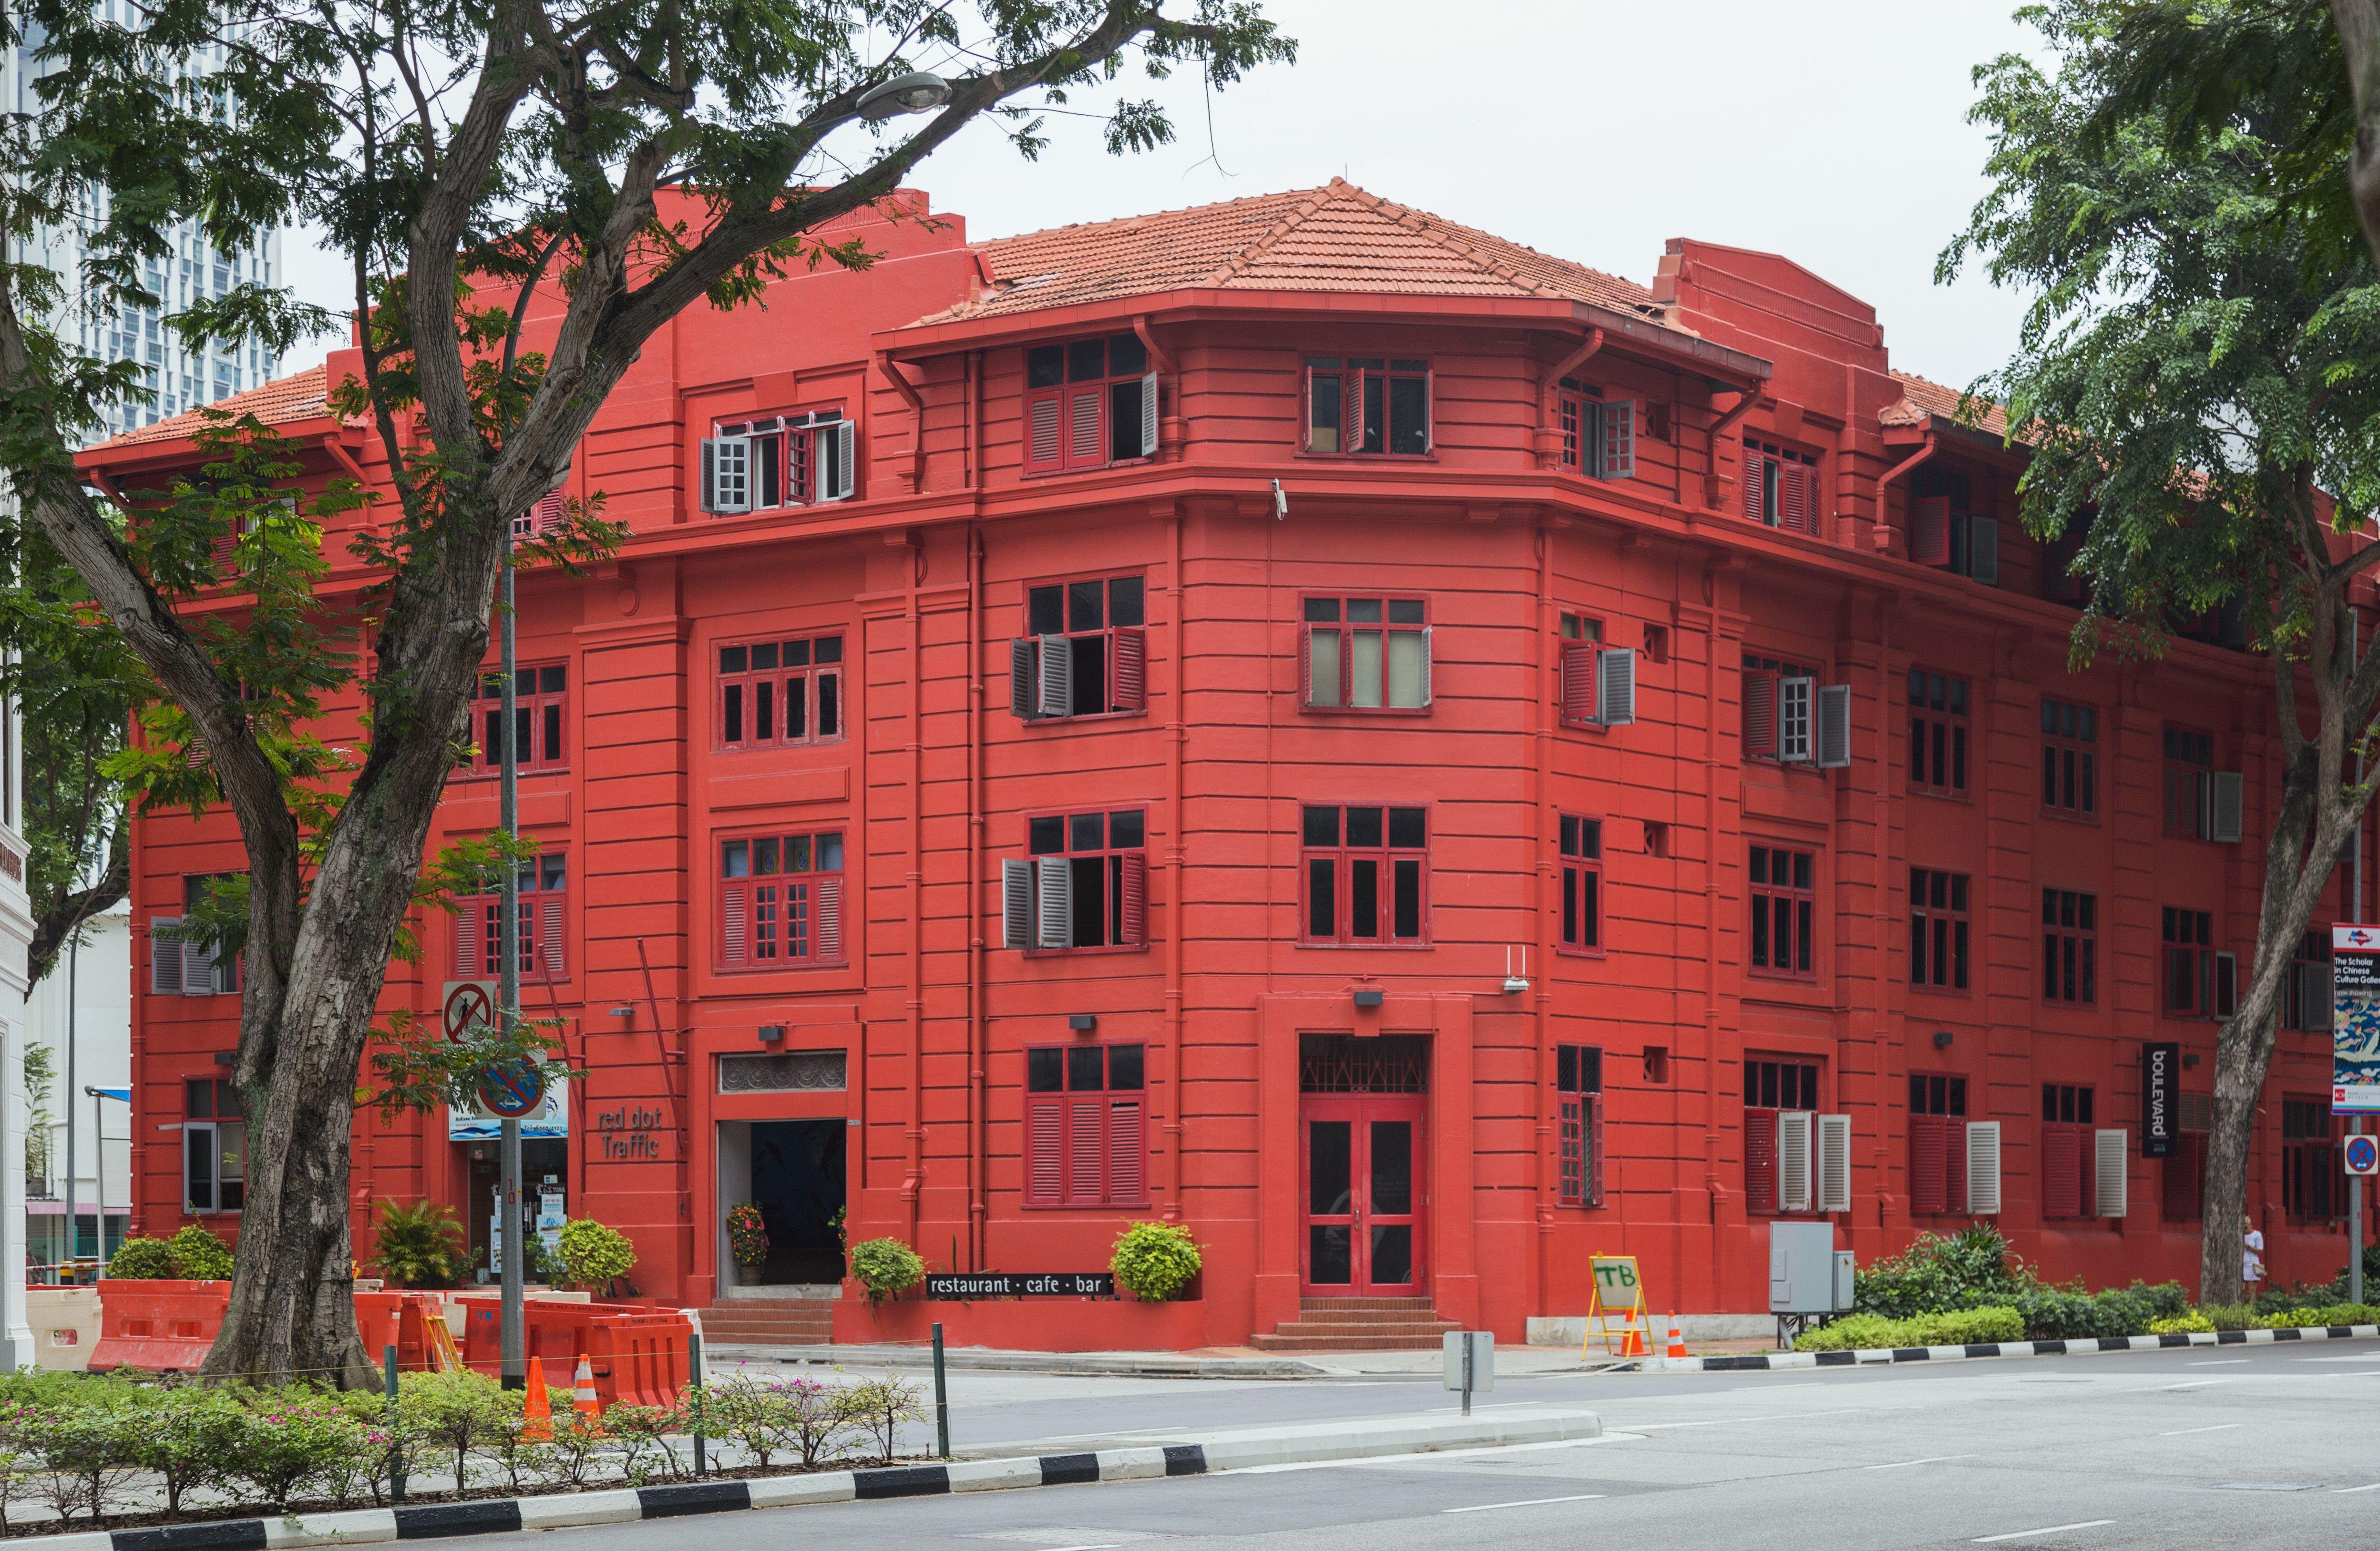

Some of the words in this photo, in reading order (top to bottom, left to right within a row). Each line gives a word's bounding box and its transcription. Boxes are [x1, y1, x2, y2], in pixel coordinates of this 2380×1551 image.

[2335, 957, 2347, 965] The
[2349, 957, 2373, 966] Scholar
[2343, 966, 2370, 975] Chinese
[2335, 975, 2359, 983] Culture
[2349, 989, 2372, 998] showing
[598, 1106, 625, 1129] red
[631, 1106, 661, 1129] dot
[602, 1133, 658, 1158] Traffic
[1595, 1265, 1635, 1287] TB
[931, 1277, 1010, 1292] restaurant
[1026, 1276, 1058, 1292] cafe
[1076, 1275, 1101, 1292] bar
